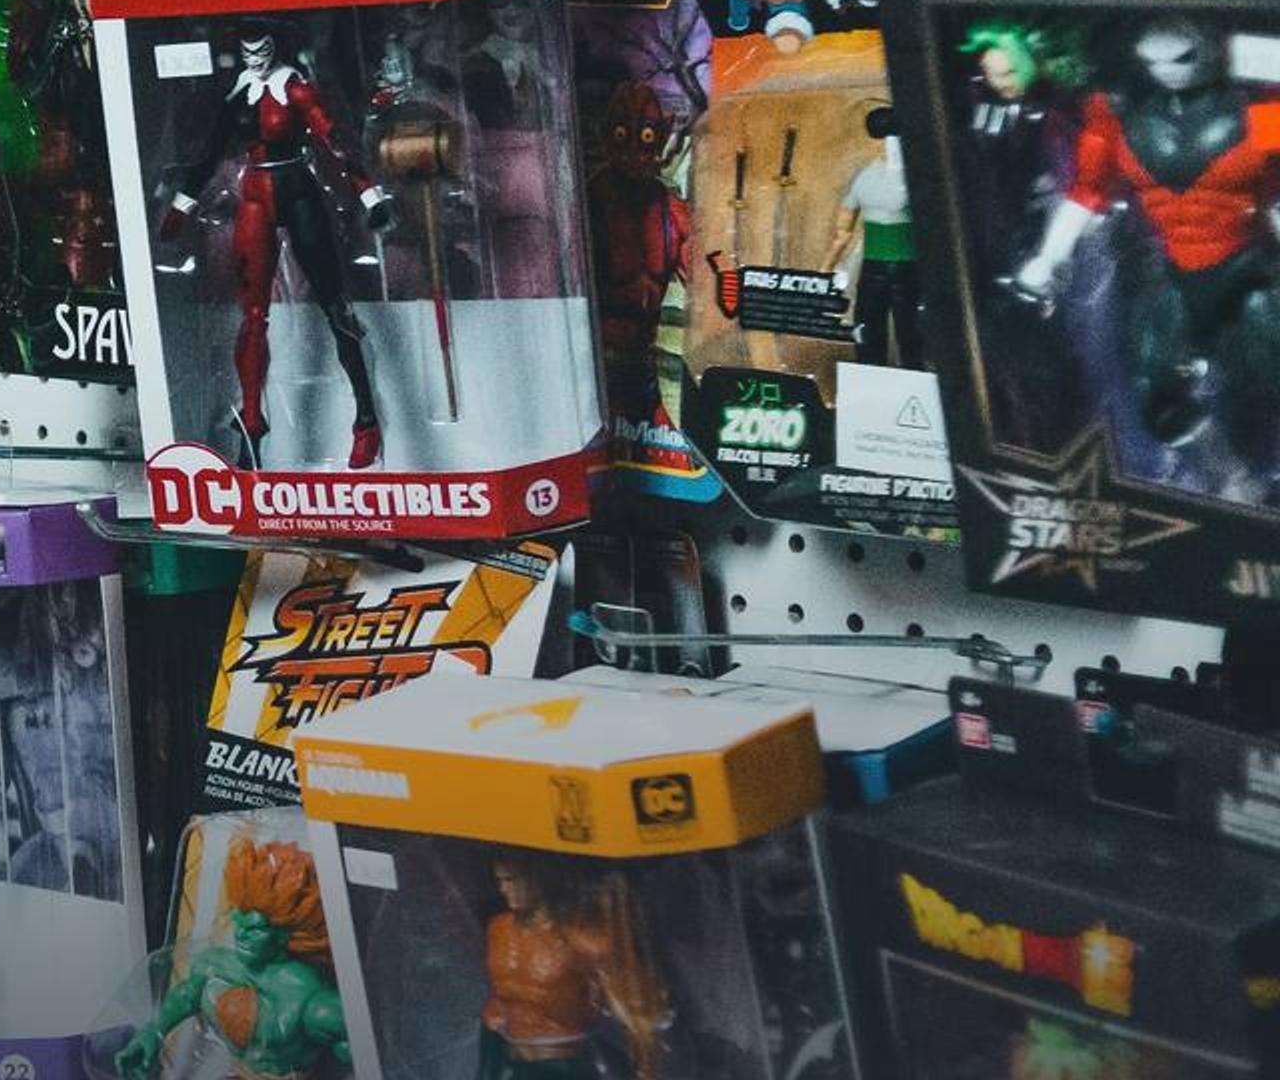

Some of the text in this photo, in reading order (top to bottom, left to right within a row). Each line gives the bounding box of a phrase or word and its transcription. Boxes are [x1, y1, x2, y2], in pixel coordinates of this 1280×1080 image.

[720, 406, 806, 448] ZORO
[147, 466, 492, 528] DC COLLECTIBLES
[530, 485, 554, 508] 13
[1009, 494, 1123, 521] DRAGON
[258, 518, 397, 532] DIRECT FROM THE SOURCE
[1007, 520, 1124, 555] STARS
[242, 579, 462, 654] STREET
